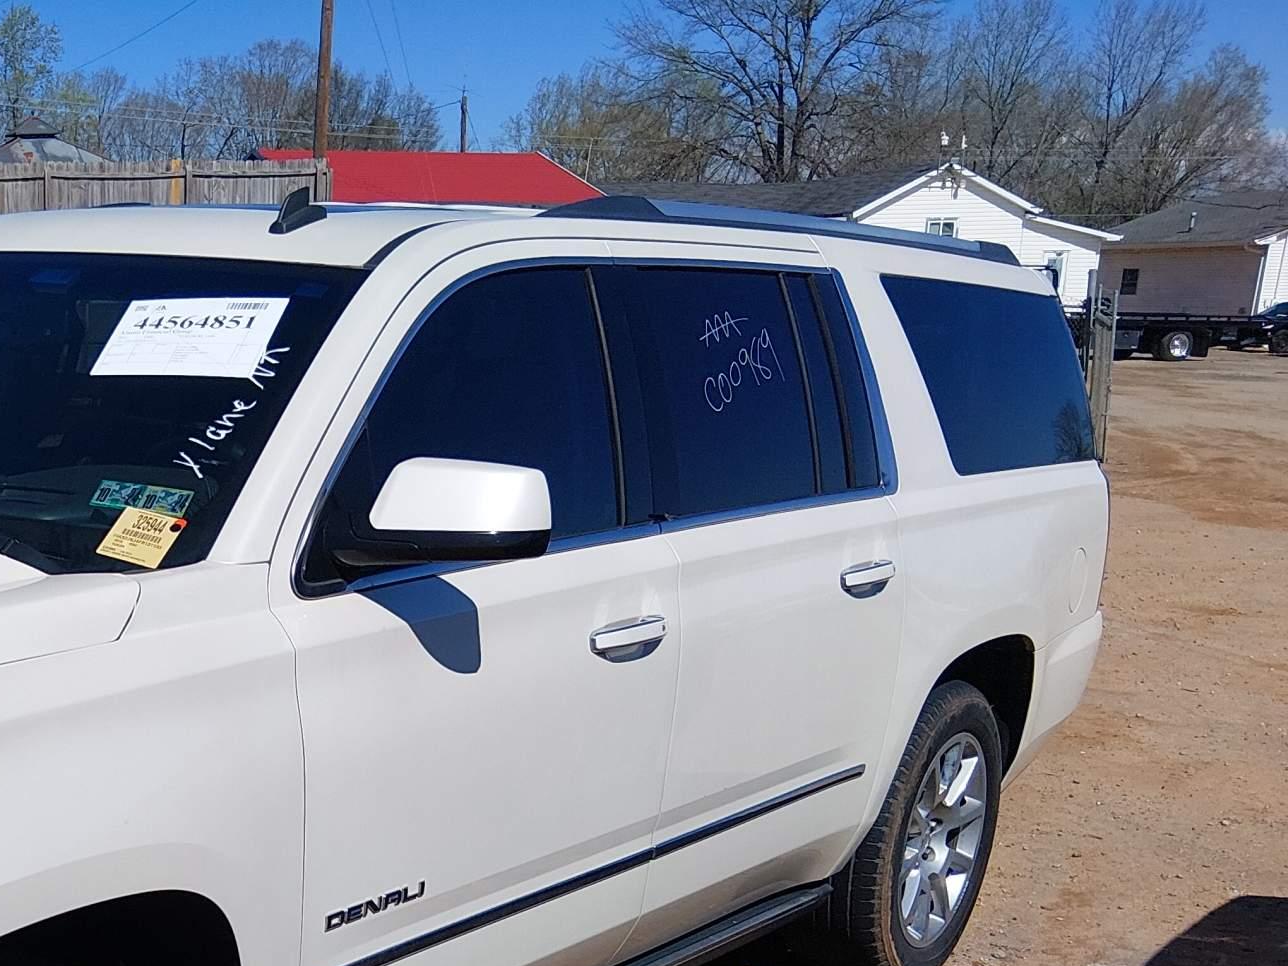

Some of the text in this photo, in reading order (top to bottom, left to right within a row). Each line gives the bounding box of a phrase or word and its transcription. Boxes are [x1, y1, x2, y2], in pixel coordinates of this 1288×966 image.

[134, 314, 257, 330] 44564851
[131, 514, 169, 535] 325944
[324, 879, 426, 933] DENALI
